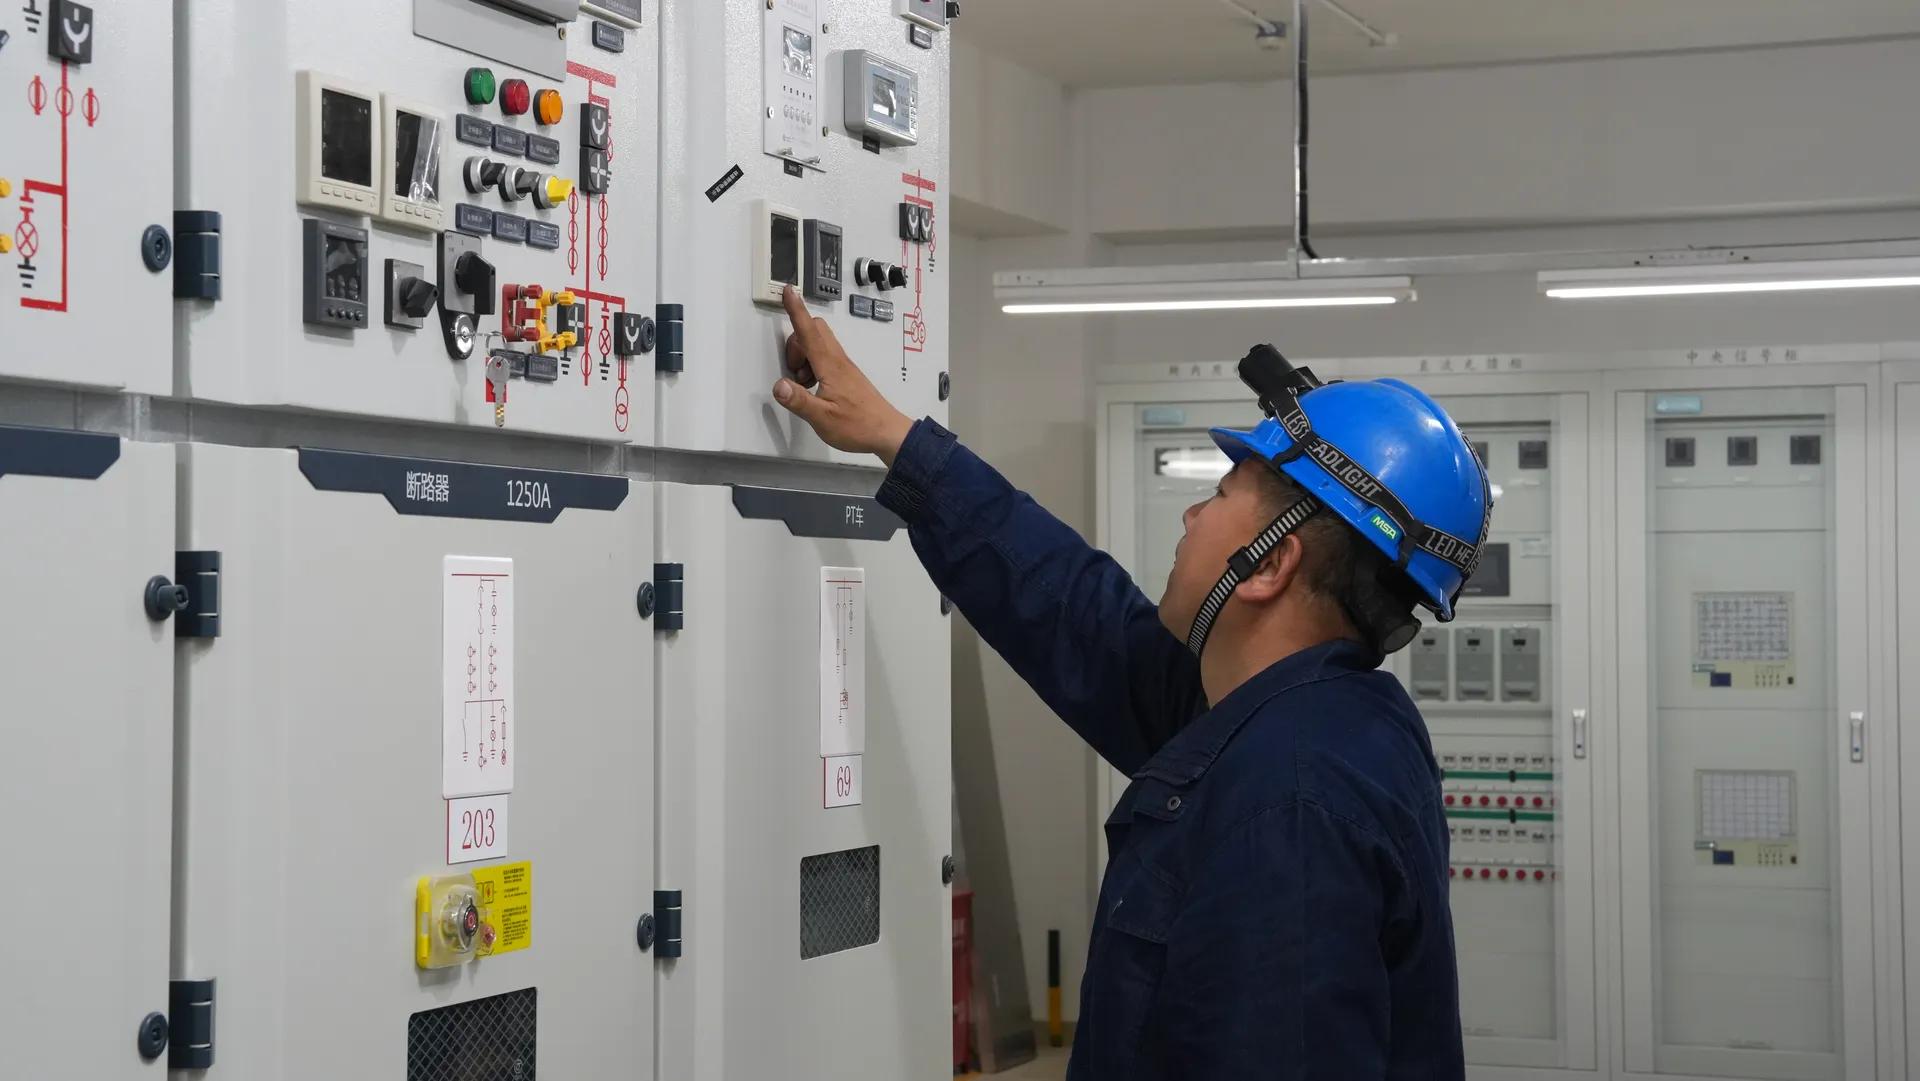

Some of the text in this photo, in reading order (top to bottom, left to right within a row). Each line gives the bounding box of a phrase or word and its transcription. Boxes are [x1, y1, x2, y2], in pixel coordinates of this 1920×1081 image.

[406, 471, 551, 508] 断路器 1250A
[846, 505, 864, 527] PT车
[1373, 516, 1397, 539] MSA
[1424, 531, 1456, 557] LED
[837, 765, 851, 797] 69
[462, 808, 495, 849] 203
